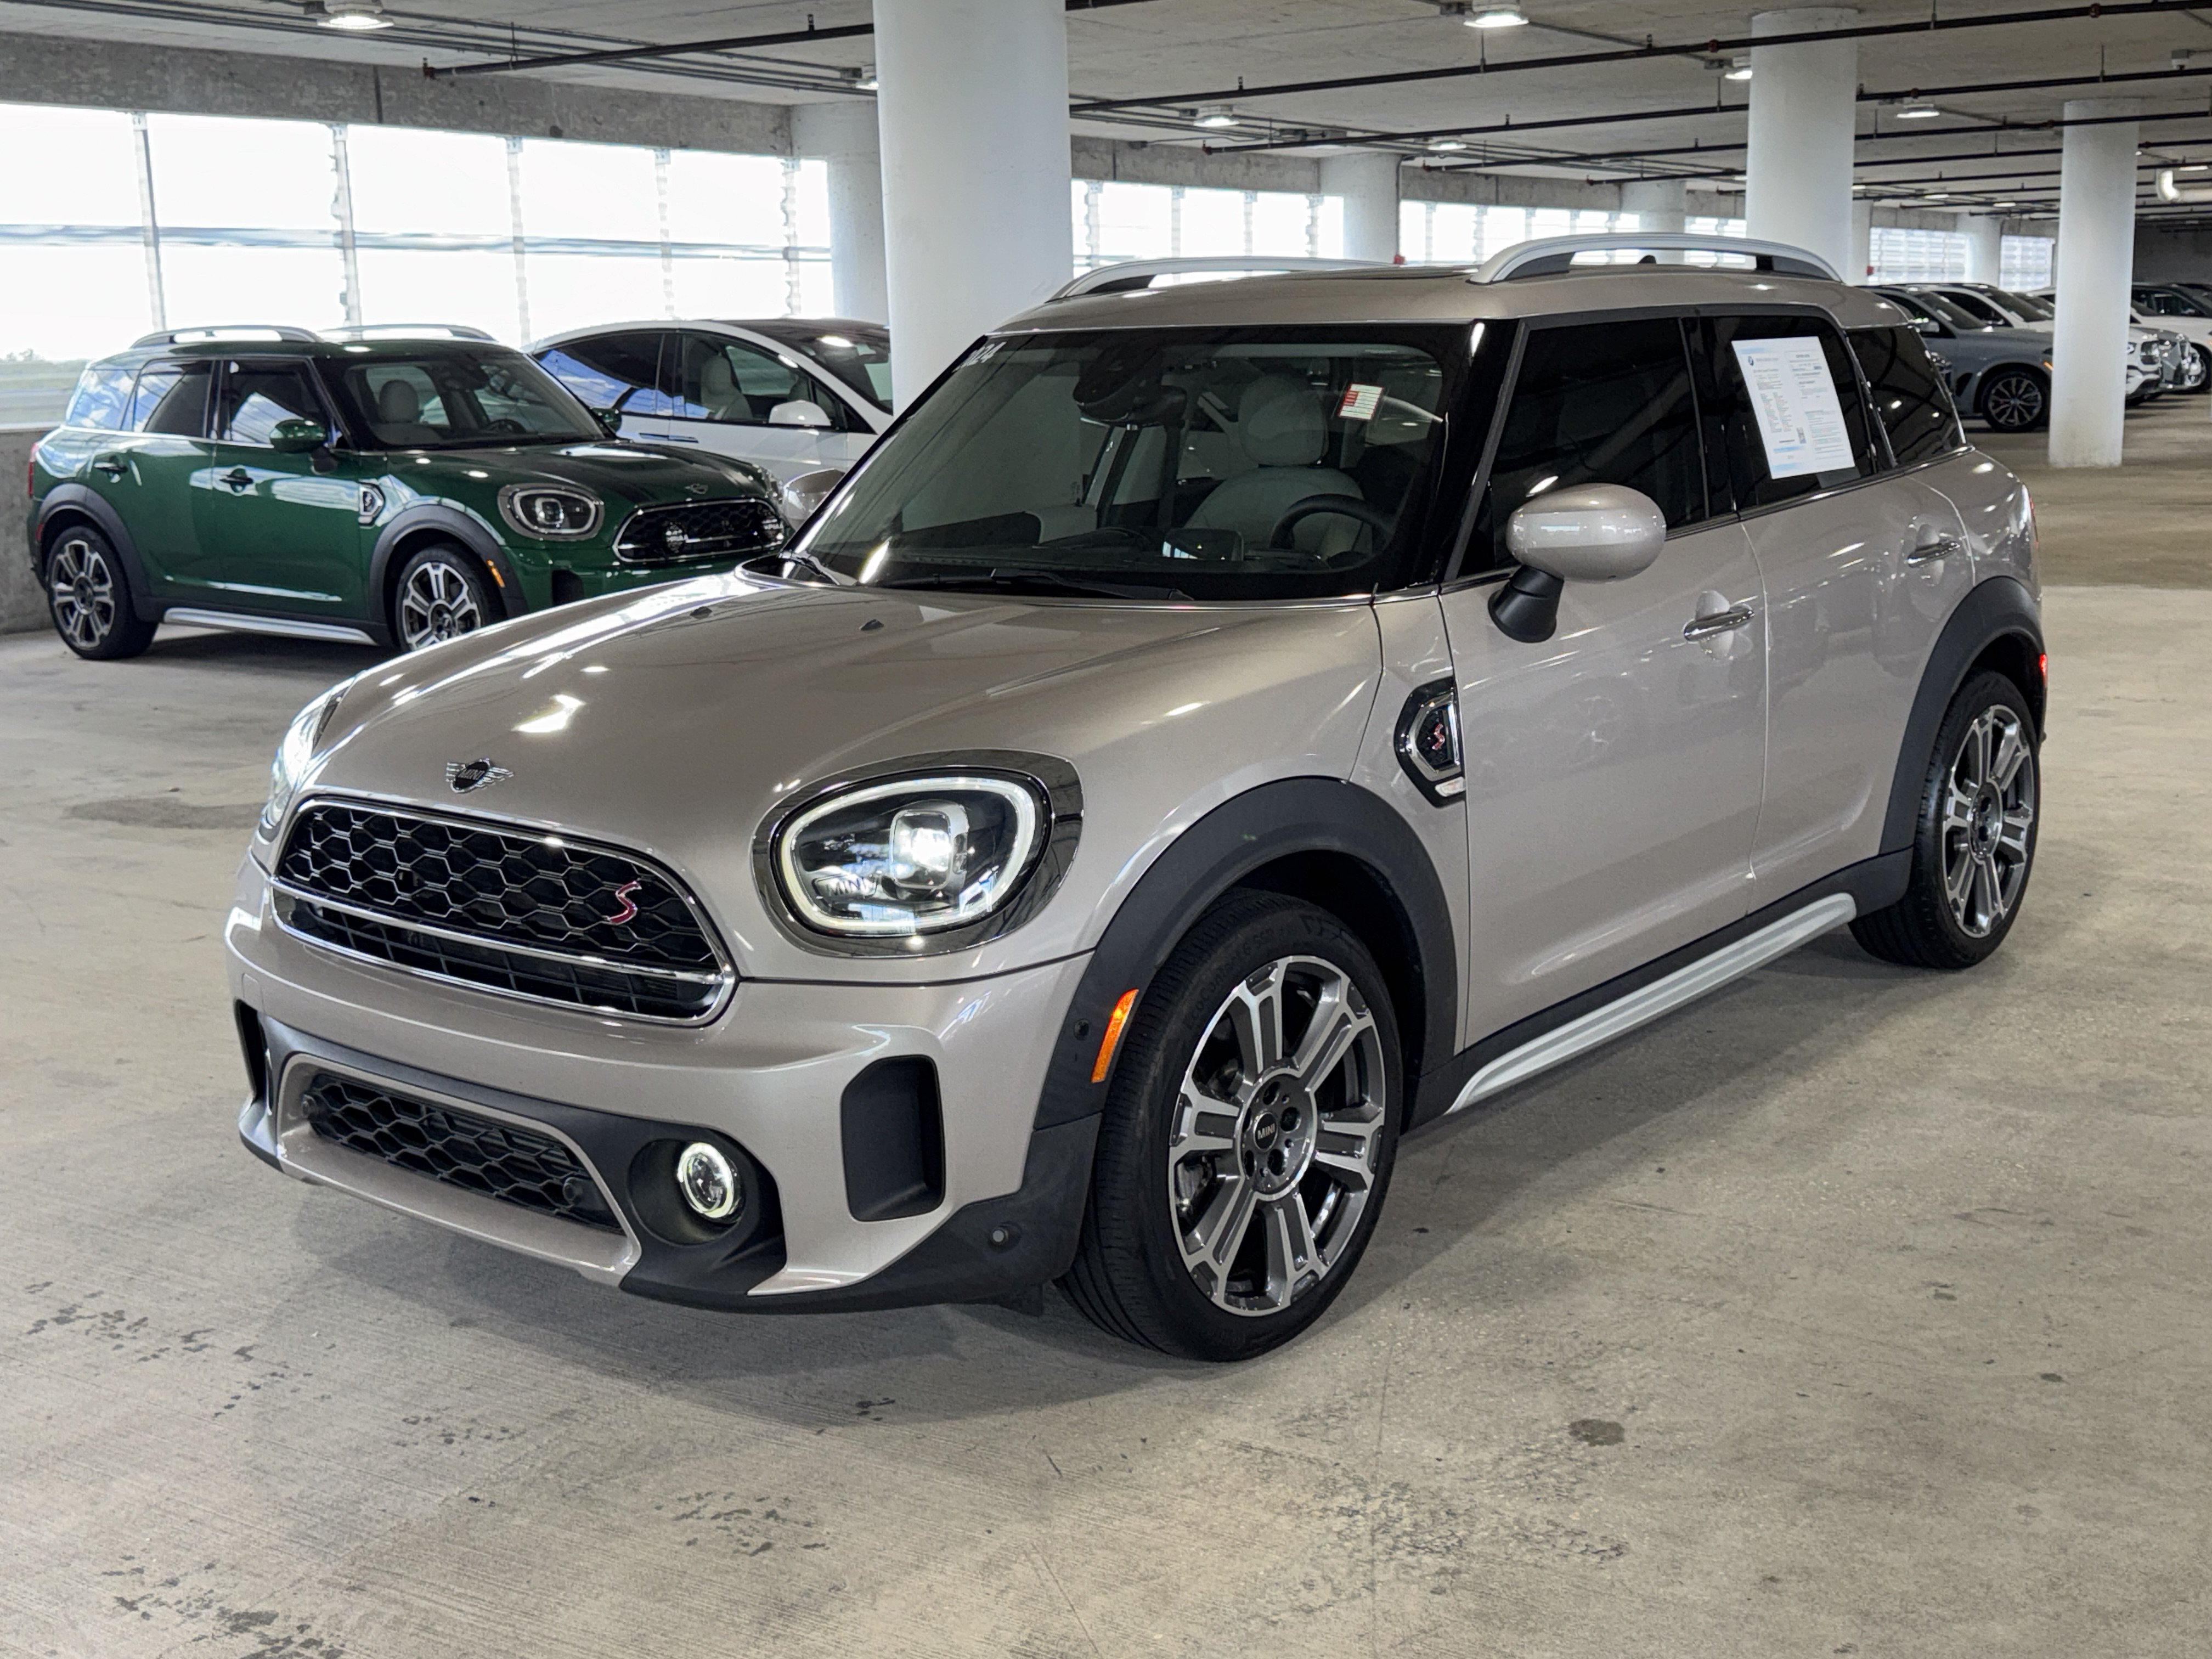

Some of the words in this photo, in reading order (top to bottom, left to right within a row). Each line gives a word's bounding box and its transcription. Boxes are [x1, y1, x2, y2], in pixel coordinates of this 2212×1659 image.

[458, 769, 486, 781] MINI
[607, 880, 642, 926] S
[1257, 1123, 1276, 1140] MINI
